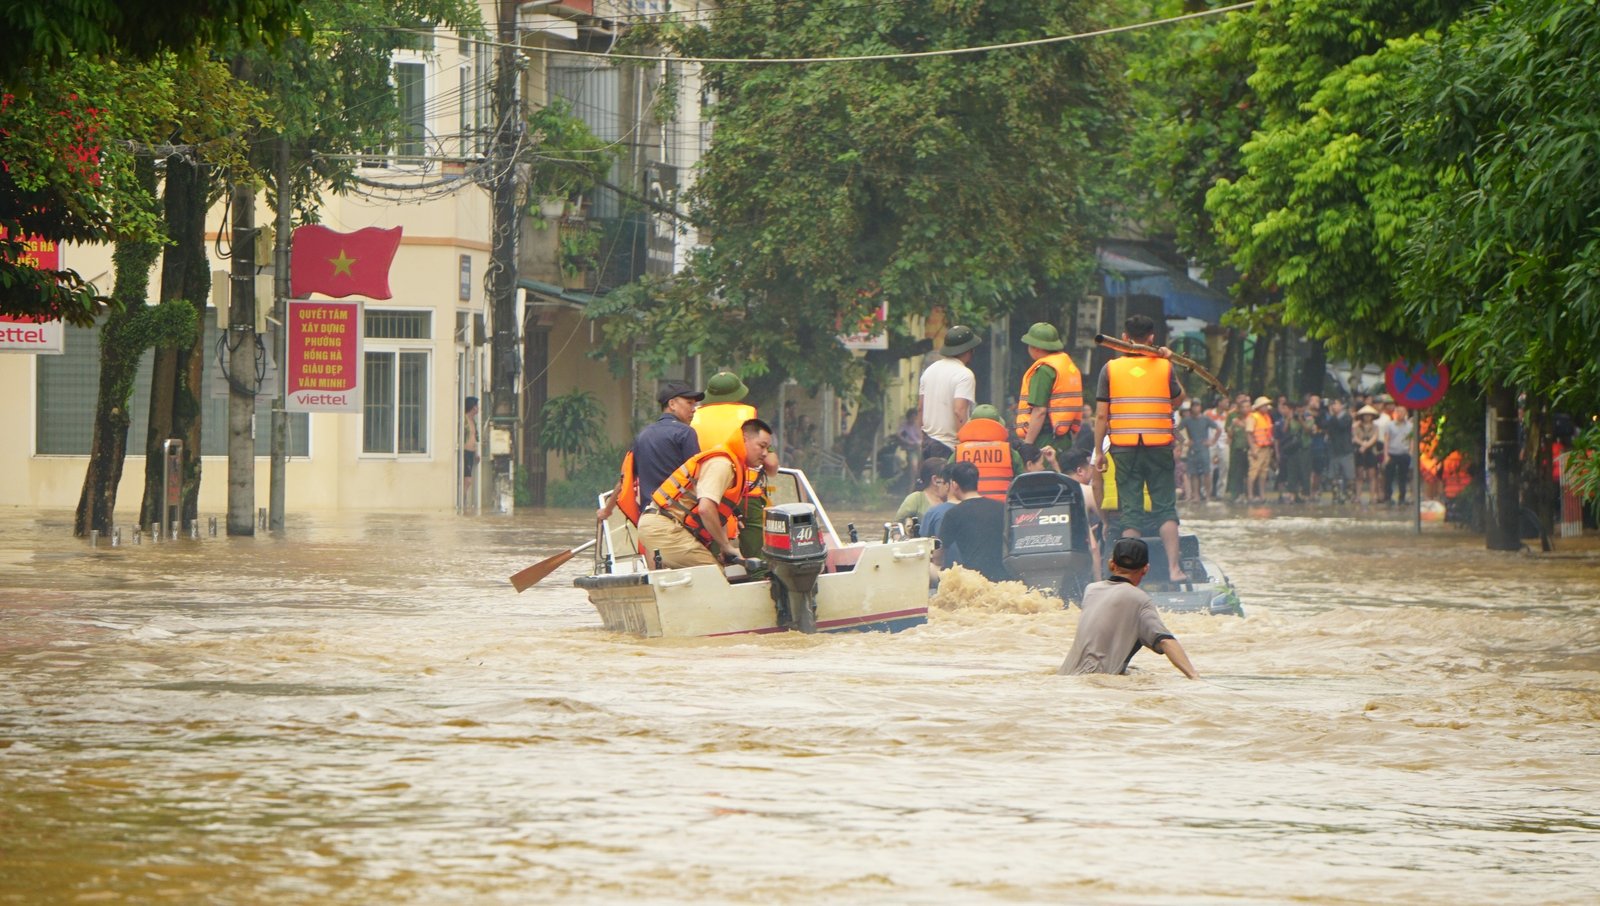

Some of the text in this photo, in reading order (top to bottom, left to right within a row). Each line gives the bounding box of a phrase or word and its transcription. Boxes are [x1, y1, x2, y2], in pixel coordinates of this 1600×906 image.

[299, 307, 348, 319] QUYẾT TÂM
[301, 321, 345, 335] XÂY DỰNG
[330, 349, 342, 360] HÀ
[302, 362, 343, 376] GIÀU ĐẸP
[298, 376, 346, 388] VĂN MINH!
[297, 393, 348, 405] viettel
[962, 449, 1003, 463] CAND
[1038, 514, 1070, 525] 200
[796, 526, 813, 541] 40
